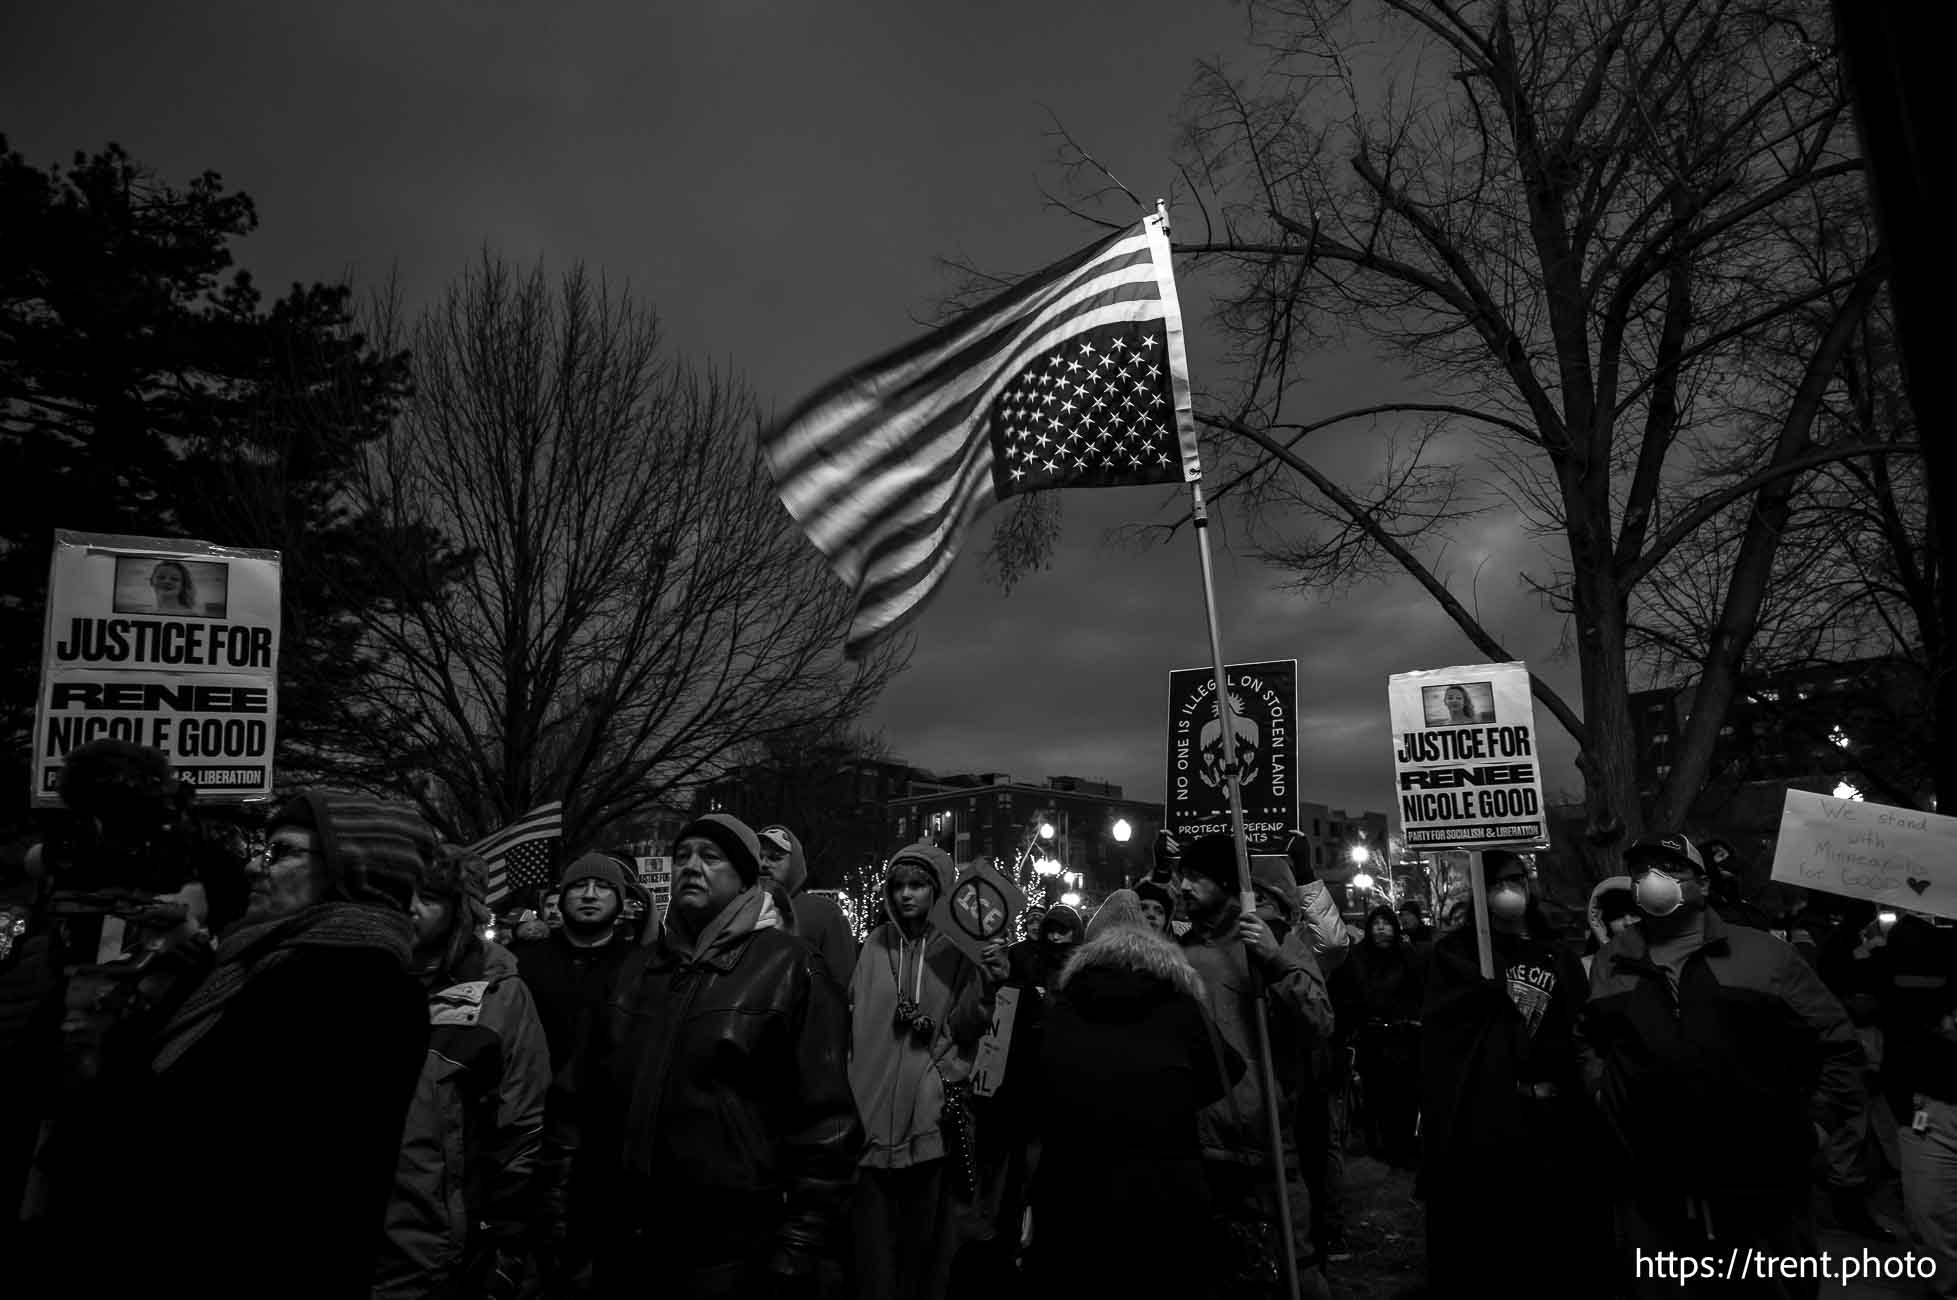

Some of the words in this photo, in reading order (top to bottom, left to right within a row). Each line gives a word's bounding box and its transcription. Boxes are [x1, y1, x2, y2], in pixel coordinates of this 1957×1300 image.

[57, 618, 204, 664] JUSTICE
[208, 625, 271, 667] FOR
[51, 683, 268, 713] RENEE
[1182, 674, 1236, 716] ILLEGL
[1241, 675, 1264, 693] ON
[1177, 720, 1191, 733] IS
[1262, 690, 1285, 748] STOLEN
[179, 719, 267, 758] GOOD
[1177, 738, 1190, 770] ONE
[1398, 729, 1486, 763] JUSTICE
[1487, 726, 1531, 757] FOR
[197, 769, 262, 784] LIBERATION
[1176, 776, 1189, 801] NO
[1271, 754, 1286, 797] LAND
[1400, 764, 1534, 791] RENEE
[1403, 791, 1476, 822] NICOLE
[1479, 788, 1538, 818] GOOD
[1821, 799, 1857, 821] We
[1878, 813, 1928, 831] stand
[1178, 823, 1228, 834] PROTECT
[1408, 830, 1431, 841] PARTY
[1431, 829, 1446, 840] FOR
[1446, 827, 1485, 840] SOCIALISM
[1486, 826, 1496, 838] &
[1496, 824, 1540, 837] LIBERATION
[957, 884, 1004, 936] ICE
[1528, 966, 1557, 993] CITY
